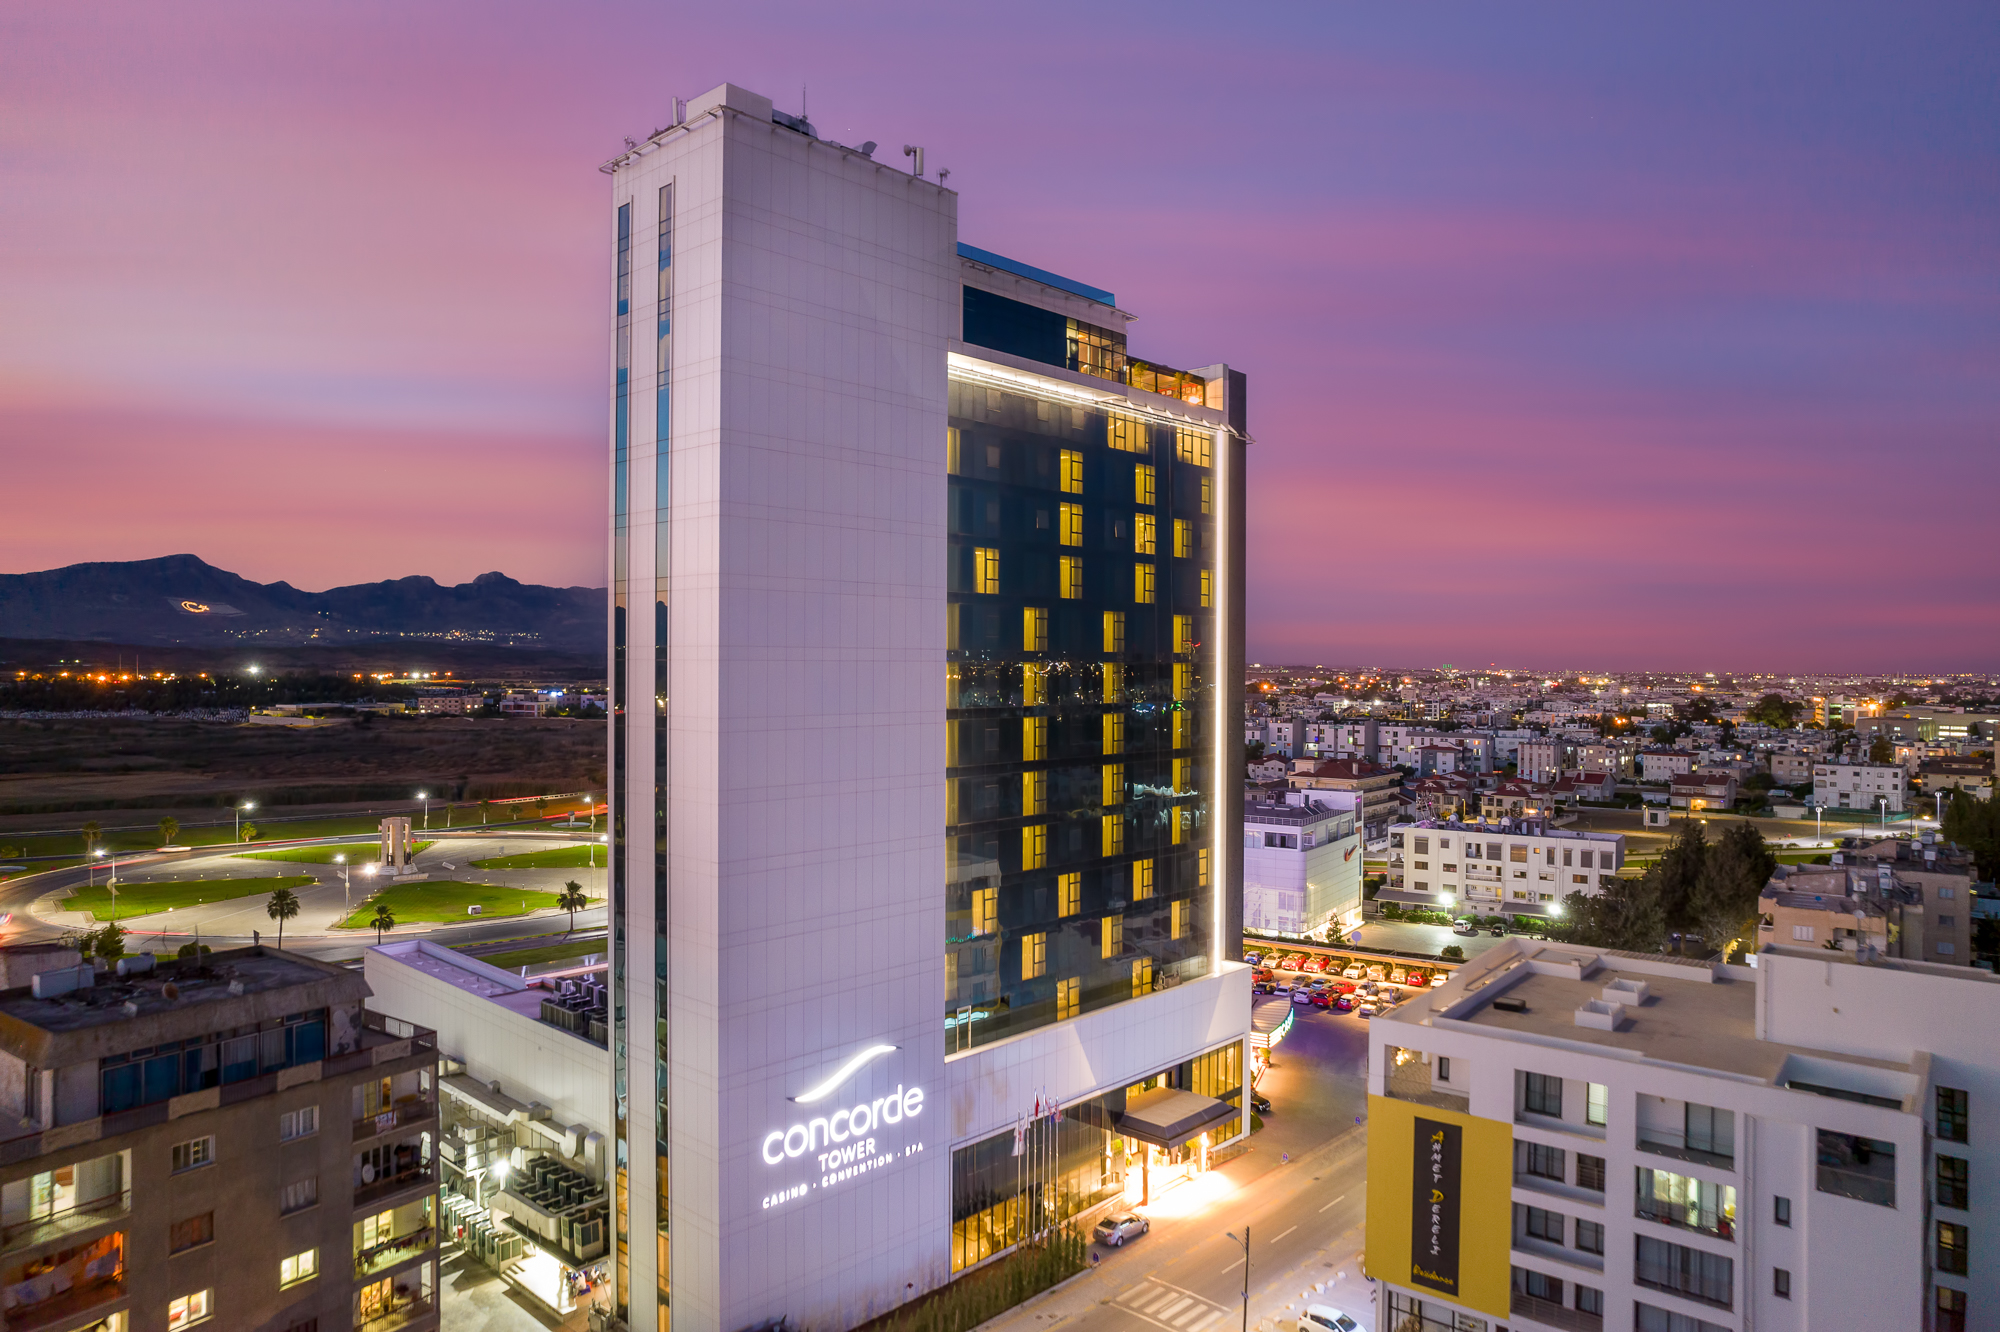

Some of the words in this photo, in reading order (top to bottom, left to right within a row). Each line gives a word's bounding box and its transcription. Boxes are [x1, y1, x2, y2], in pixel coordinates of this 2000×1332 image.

[762, 1084, 924, 1165] concorde
[817, 1137, 876, 1172] TOWER
[762, 1183, 808, 1209] CASINO
[821, 1152, 893, 1188] CONVENTION
[905, 1142, 924, 1158] SPA
